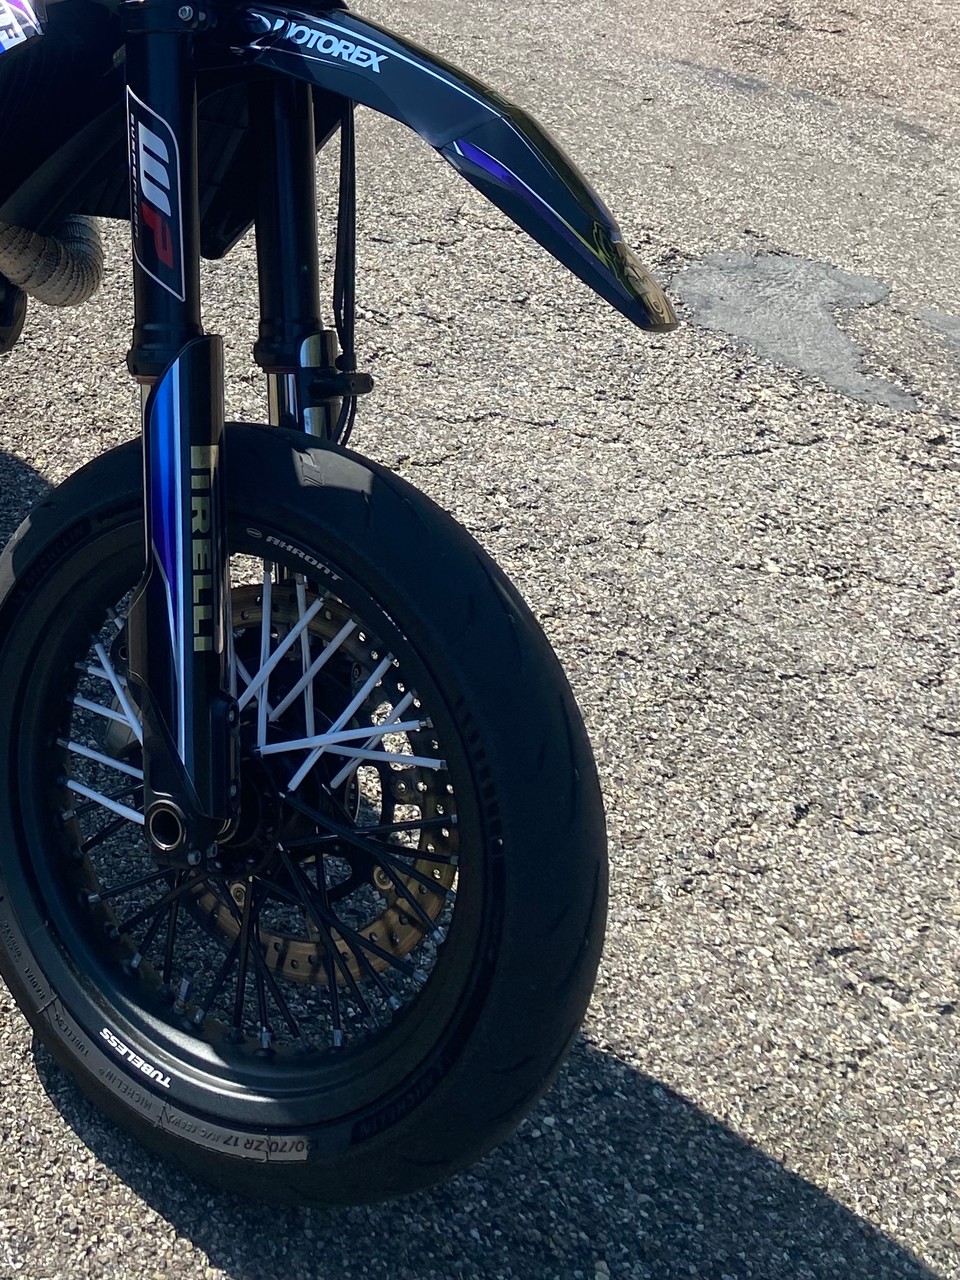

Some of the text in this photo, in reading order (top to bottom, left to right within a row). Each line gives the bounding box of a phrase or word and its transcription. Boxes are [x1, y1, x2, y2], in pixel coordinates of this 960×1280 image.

[98, 1026, 173, 1089] TUBELESS
[222, 1134, 240, 1147] 17
[243, 1137, 265, 1152] ZR
